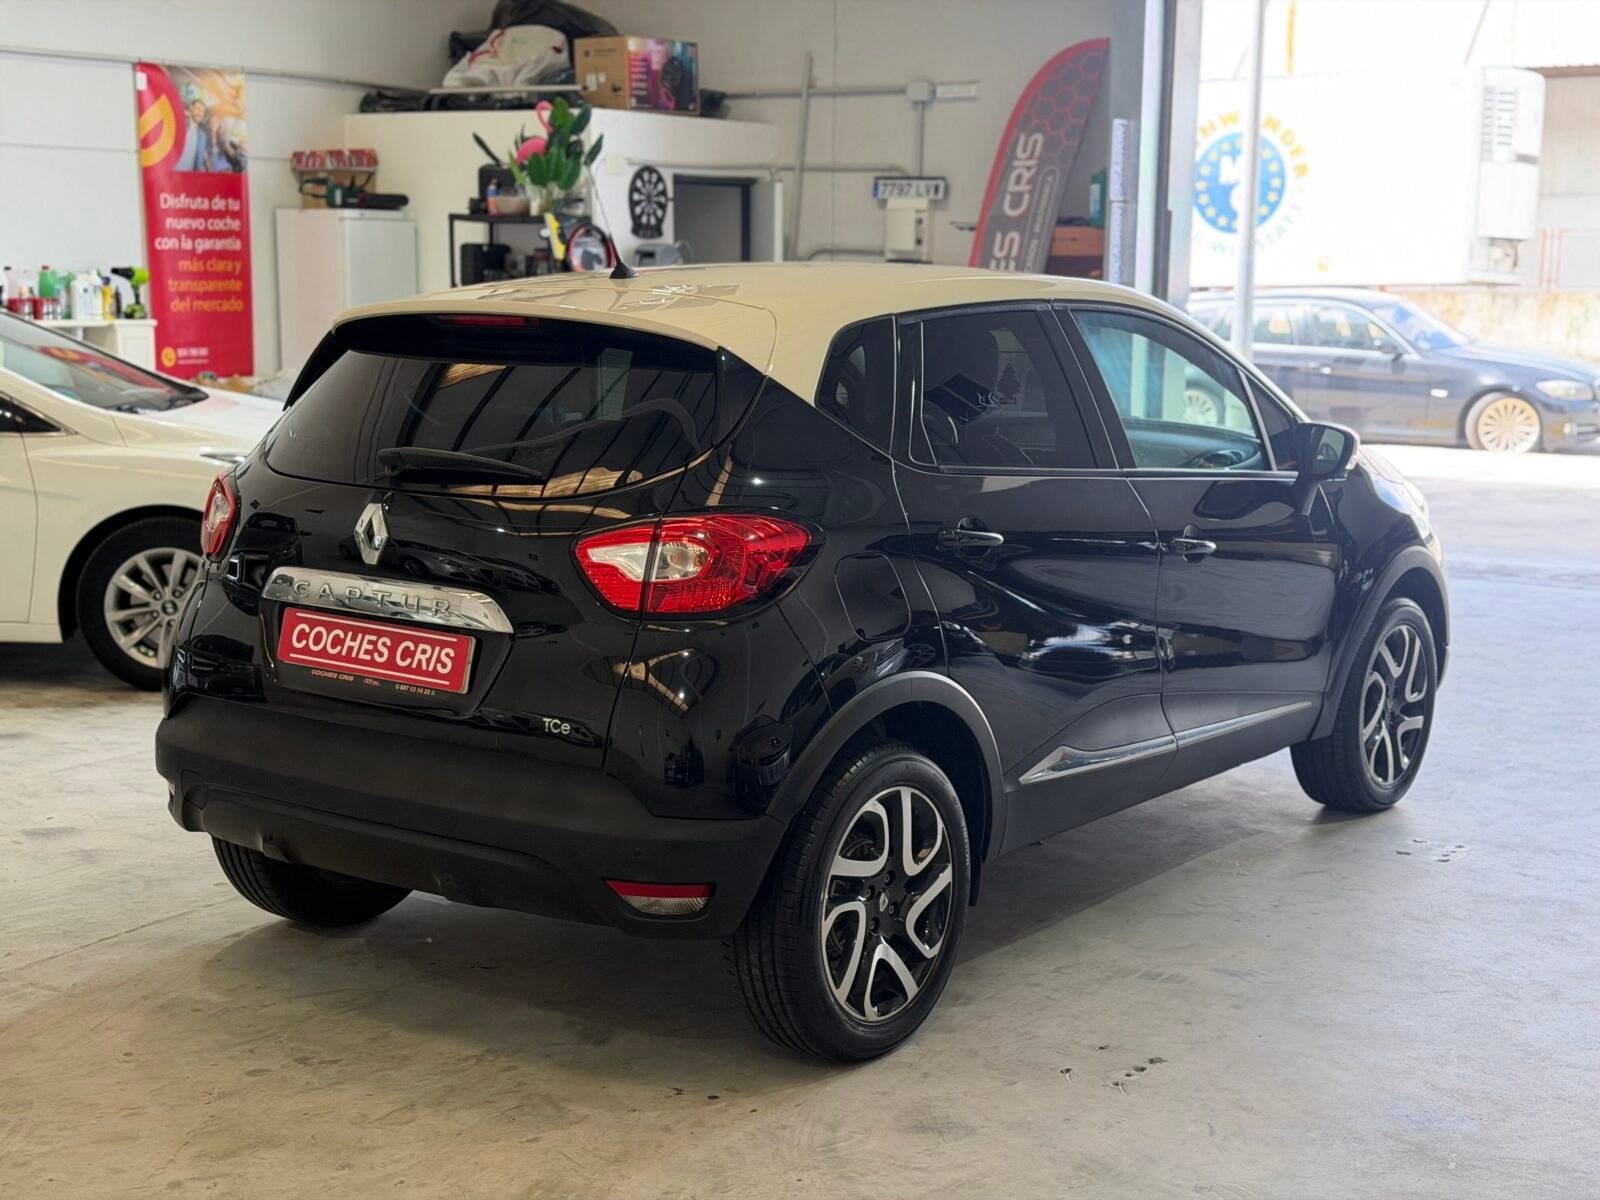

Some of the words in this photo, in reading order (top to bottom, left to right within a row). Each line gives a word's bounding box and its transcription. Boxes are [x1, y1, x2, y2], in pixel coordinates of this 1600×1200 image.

[1003, 132, 1045, 217] CRIS
[160, 193, 209, 211] Disfruta
[211, 195, 226, 211] de
[227, 197, 240, 211] tu
[166, 217, 205, 230] nuevo
[207, 216, 241, 231] coche
[154, 236, 178, 250] con
[181, 235, 192, 250] la
[206, 259, 233, 273] clara
[234, 260, 242, 275] y
[168, 279, 242, 293] transparente
[170, 298, 191, 313] del
[192, 298, 244, 312] mercado
[293, 581, 451, 617] CAPTUR
[291, 623, 391, 662] COCHES
[395, 641, 455, 674] CRIS
[311, 669, 338, 680] COCHES
[338, 674, 354, 682] CRIS
[542, 717, 571, 735] TCe
